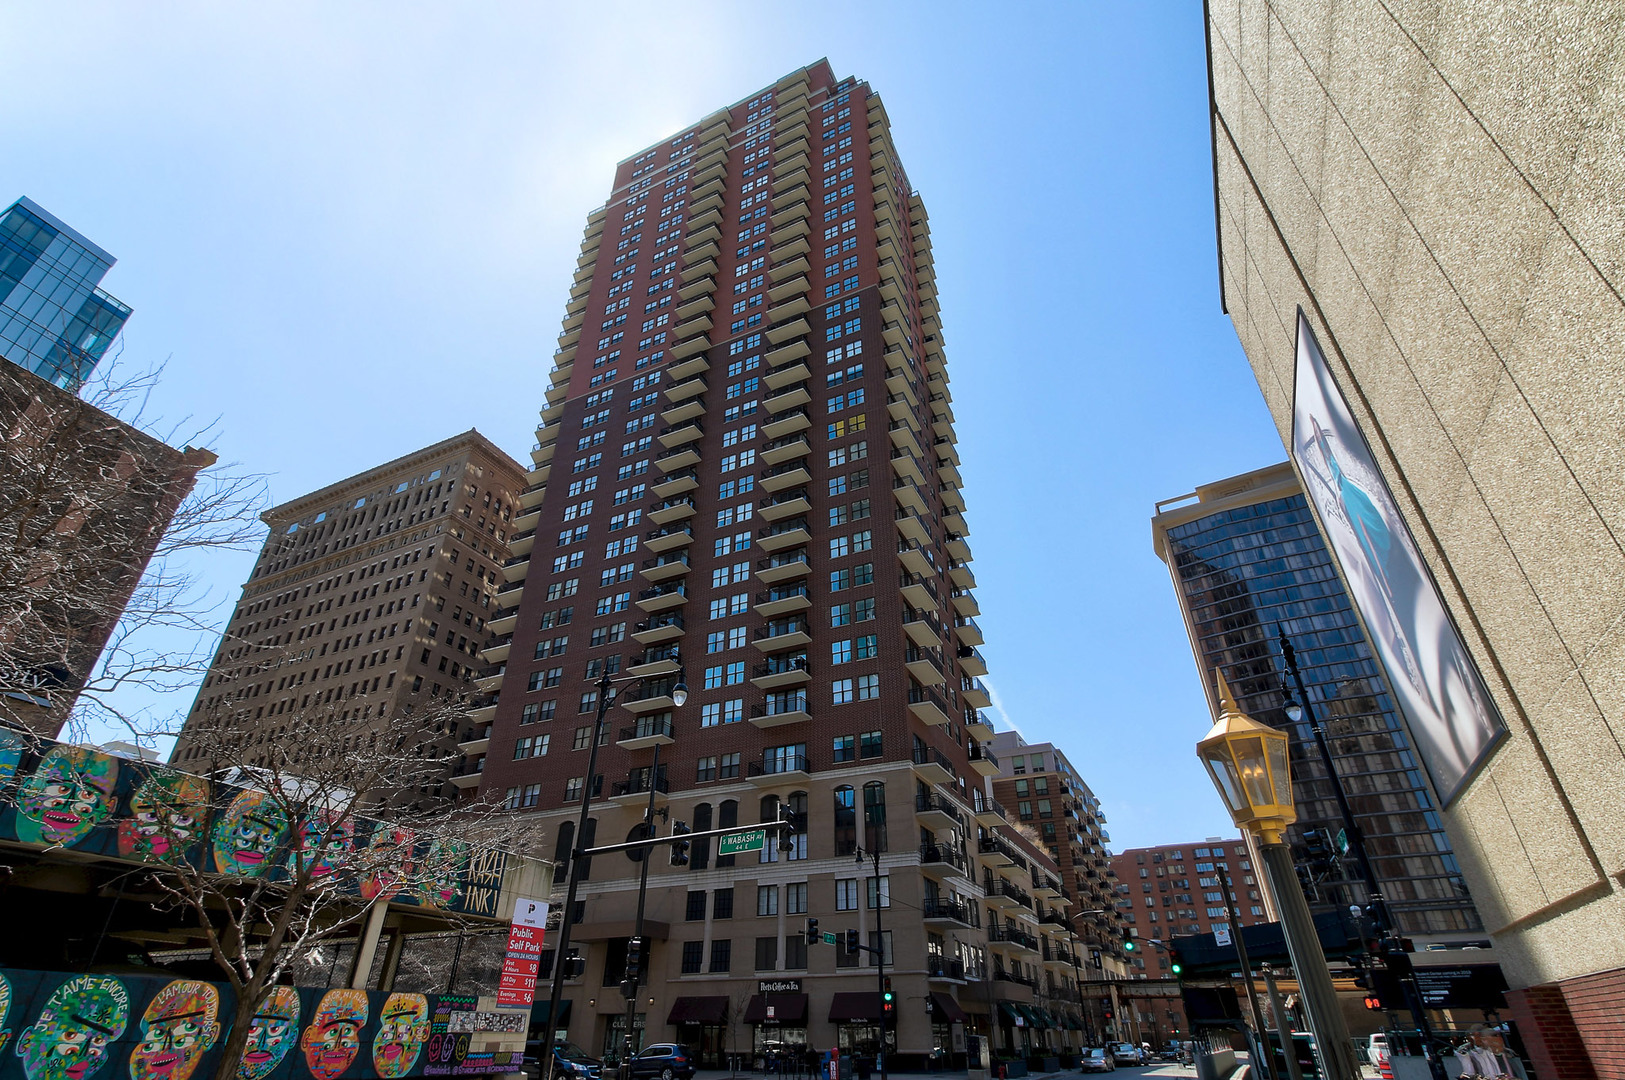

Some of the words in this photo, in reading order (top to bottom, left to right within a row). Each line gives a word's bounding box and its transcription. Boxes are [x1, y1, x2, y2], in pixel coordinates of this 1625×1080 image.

[727, 834, 756, 845] WABASH
[511, 927, 534, 939] Public
[509, 939, 525, 950] Self
[525, 943, 541, 953] Park
[529, 963, 537, 973] $8
[524, 978, 535, 988] $11
[789, 981, 799, 990] Tea
[157, 983, 201, 1005] L'AMOUR
[524, 993, 532, 1003] $6
[34, 1011, 54, 1032] JE
[47, 977, 97, 1006] T'AIME
[288, 990, 300, 1015] EVER
[511, 1052, 524, 1065] 2015
